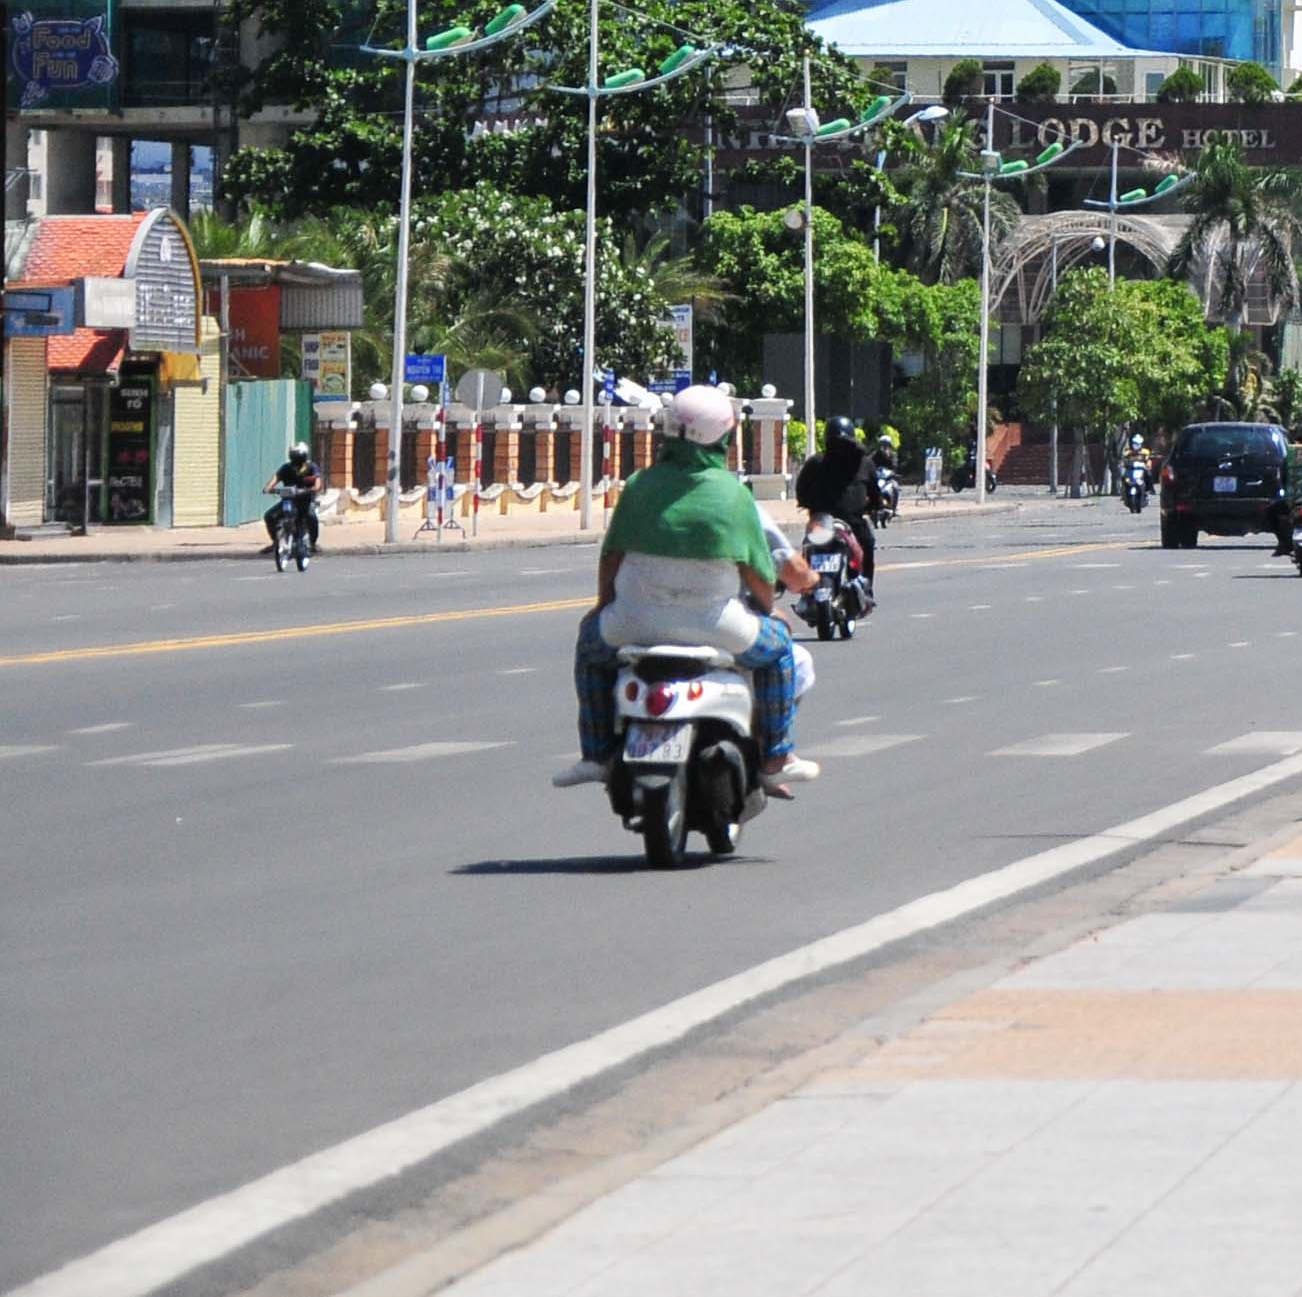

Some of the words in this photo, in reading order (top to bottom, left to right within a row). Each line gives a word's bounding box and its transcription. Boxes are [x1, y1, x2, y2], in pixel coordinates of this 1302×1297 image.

[32, 26, 92, 49] Food
[32, 51, 79, 80] Fun
[1009, 118, 1166, 149] LODGE
[1181, 129, 1277, 149] HOTEL
